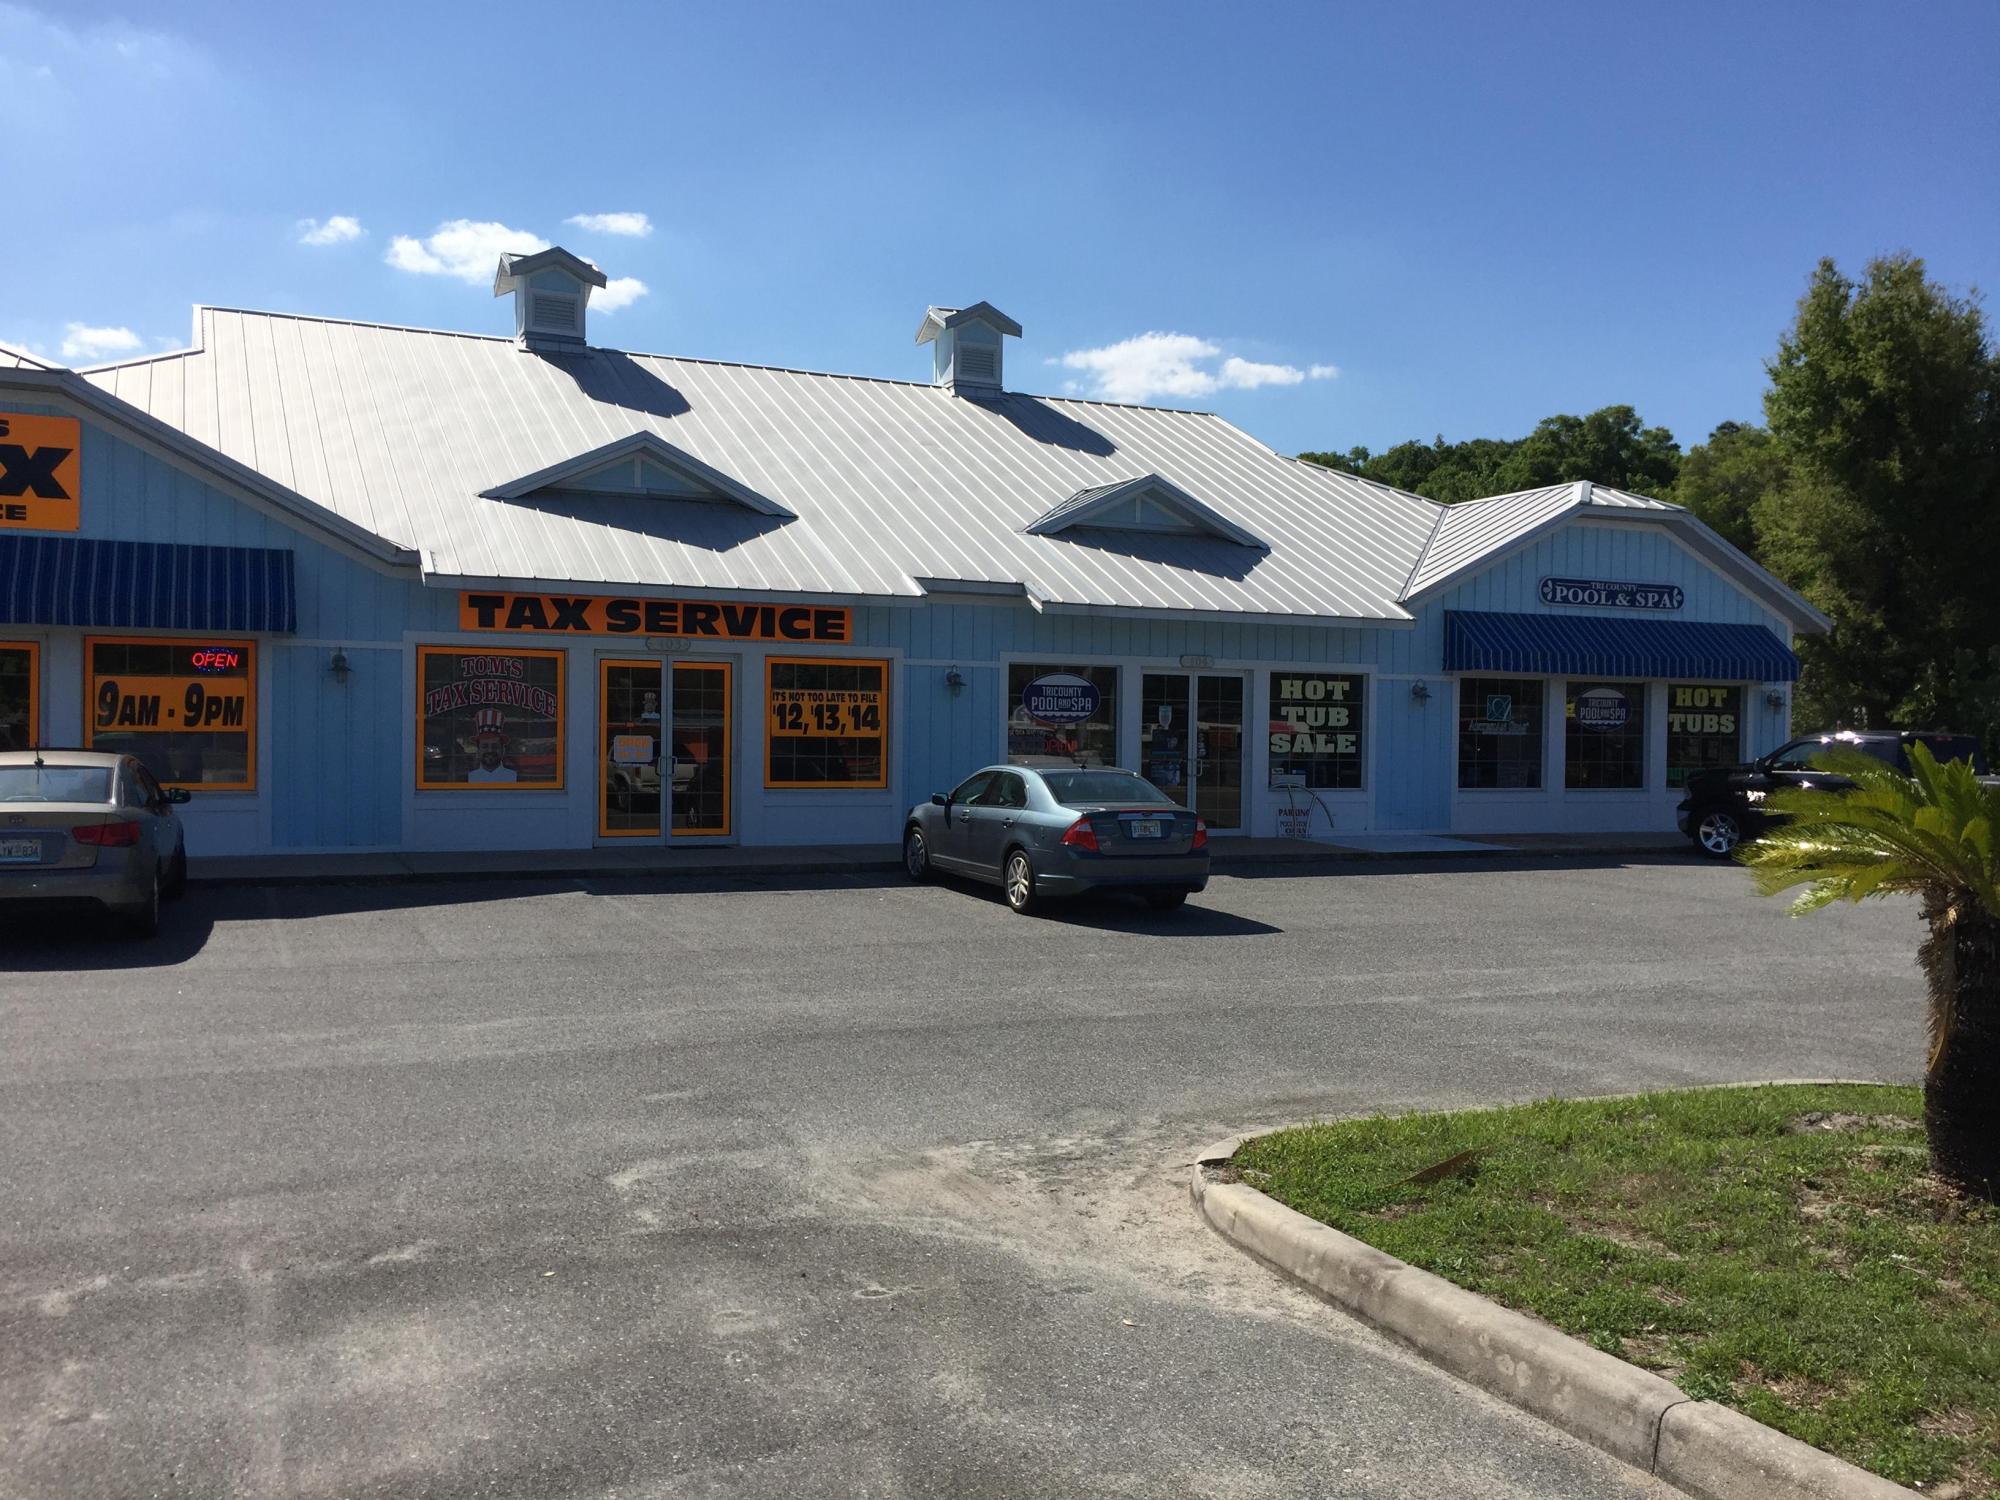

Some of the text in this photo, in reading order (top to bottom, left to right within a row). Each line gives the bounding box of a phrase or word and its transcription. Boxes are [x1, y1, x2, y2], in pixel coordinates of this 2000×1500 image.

[1555, 586, 1673, 608] POOL & SPA
[468, 595, 845, 640] TAX SERVICE
[192, 651, 240, 669] OPEN
[461, 655, 525, 679] TOM'S
[427, 678, 557, 720] TAX SERVICE
[789, 692, 805, 702] NOT
[808, 692, 824, 703] TOO
[826, 693, 846, 703] LATE
[848, 693, 858, 703] TO
[860, 693, 878, 703] FILE
[1042, 686, 1082, 697] TRICOUNTY
[1280, 679, 1350, 700] HOT
[1675, 687, 1728, 708] HOT
[97, 680, 161, 727] 9AM
[184, 682, 245, 727] 9PM
[1031, 697, 1059, 711] POOL
[1071, 697, 1092, 711] SPA
[1580, 707, 1601, 719] POOL
[1610, 707, 1626, 719] SPA
[1280, 706, 1350, 727] TUB
[1669, 713, 1736, 733] TUBS
[1270, 733, 1357, 753] SALE
